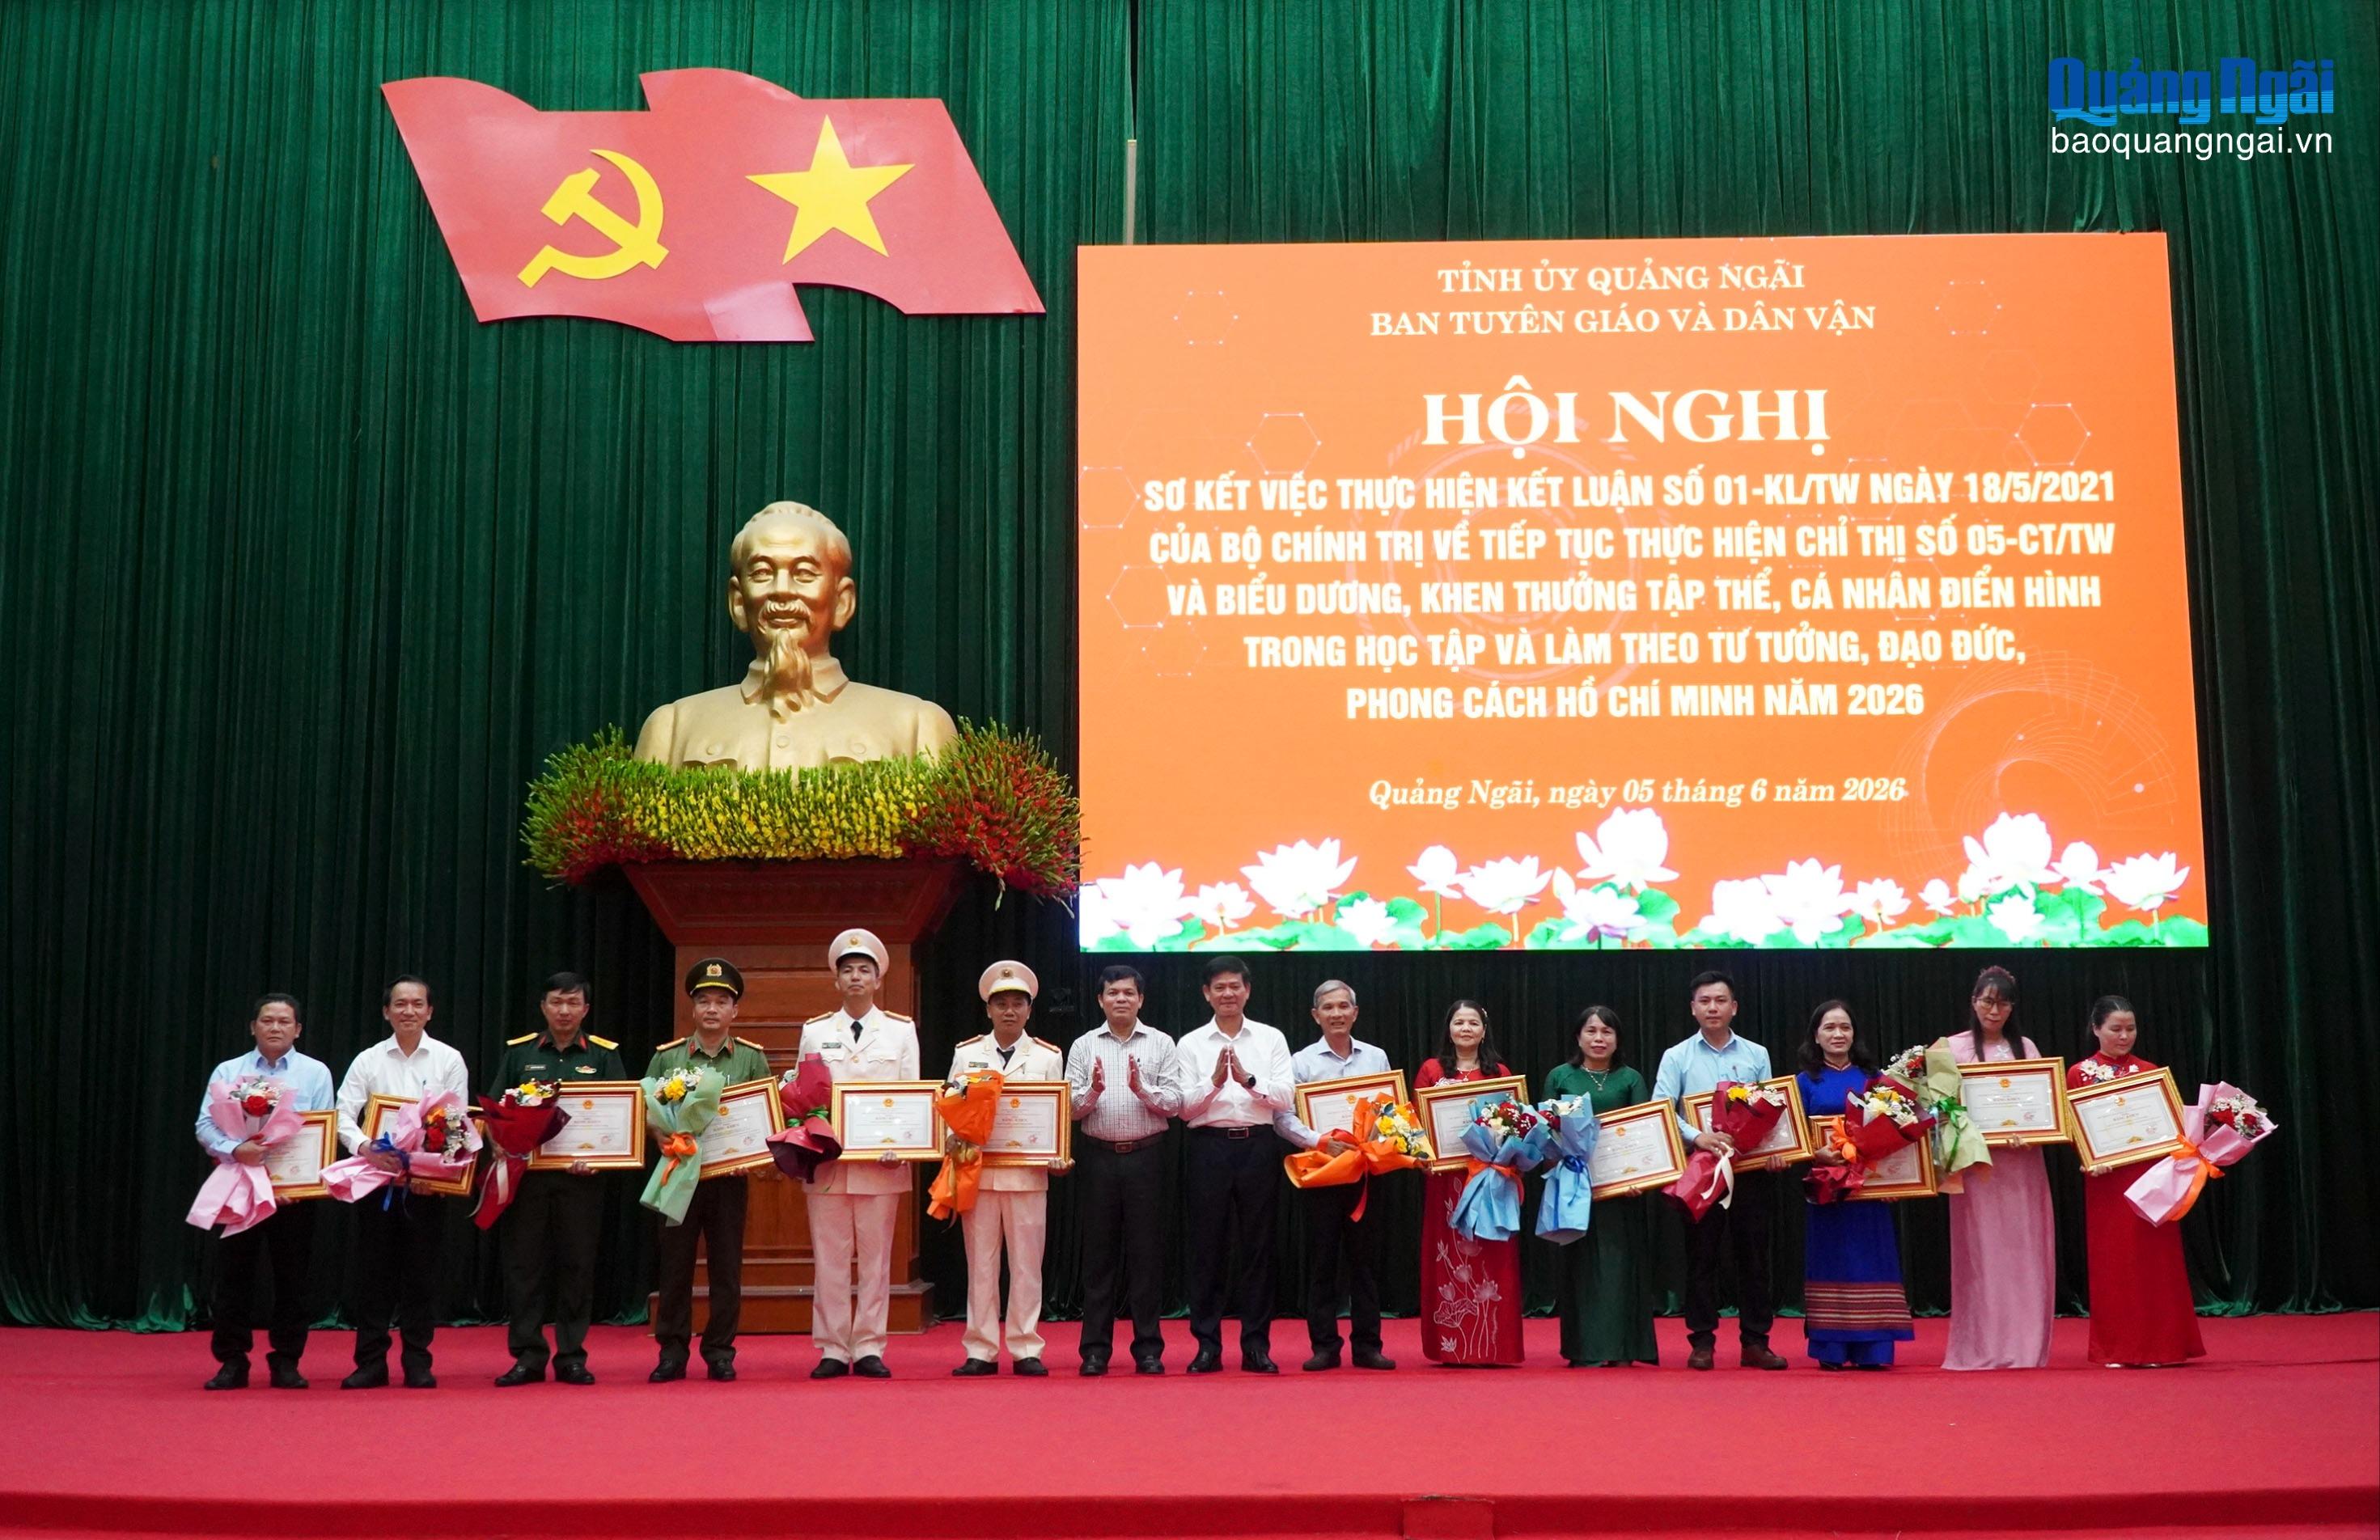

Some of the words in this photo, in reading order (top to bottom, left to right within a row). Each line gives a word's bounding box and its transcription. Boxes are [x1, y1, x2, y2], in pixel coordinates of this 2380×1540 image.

[1438, 260, 1522, 293] TỈNH
[1531, 258, 1579, 292] ỦY
[1587, 257, 1709, 294] QUẢNG
[1718, 258, 1805, 291] NGÃI
[1370, 311, 1441, 336] BAN
[1449, 303, 1565, 335] TUYÊN
[1573, 302, 1661, 333] GIÁO
[1667, 301, 1716, 332] VÀ
[1723, 300, 1796, 332] DÂN
[1803, 298, 1876, 336] VẬN
[1421, 374, 1583, 459] HỘI
[1607, 389, 1831, 456] NGHỊ
[1144, 477, 1187, 512] SƠ
[1194, 470, 1251, 510] KẾT
[1259, 470, 1328, 516] VIỆC
[1336, 476, 1417, 515] THỰC
[1424, 472, 1498, 515] HIỆN
[1506, 467, 1564, 508] KẾT
[1573, 468, 1654, 513] LUẬN
[1662, 463, 1705, 506] SỐ
[1713, 472, 1861, 506] 01-KL/TW
[1870, 465, 1954, 503] NGÀY
[1963, 470, 2115, 503] 18/5/2021
[1150, 522, 1212, 564] CỦA
[1220, 524, 1263, 569] BỘ
[1271, 525, 1367, 563] CHÍNH
[1376, 531, 1424, 567] TRỊ
[1480, 520, 1547, 560] TIẾP
[1558, 528, 1616, 565] TỤC
[1624, 524, 1704, 565] THỰC
[1713, 520, 1786, 564] HIỆN
[1796, 516, 1848, 557] CHỈ
[1857, 525, 1906, 563] THỊ
[1915, 514, 1959, 556] SỐ
[1967, 522, 2115, 556] 05-CT/TW
[1167, 578, 1208, 616] VÀ
[1215, 571, 1286, 616] BIỂU
[1295, 578, 1412, 618] DƯƠNG,
[1421, 582, 1504, 613] KHEN
[1513, 572, 1637, 612] THƯỞNG
[1645, 571, 1705, 617] TẬP
[1713, 566, 1781, 614] THỂ,
[1791, 572, 1833, 610] CÁ
[1841, 570, 1931, 609] NHÂN
[1939, 565, 2015, 608] ĐIỂN
[2024, 569, 2102, 608] HÌNH
[1243, 636, 1346, 668] TRONG
[1356, 635, 1418, 672] HỌC
[1426, 628, 1486, 672] TẬP
[1495, 627, 1536, 665] VÀ
[1544, 627, 1611, 665] LÀM
[1620, 632, 1700, 664] THEO
[1708, 627, 1751, 663] TƯ
[1755, 622, 1870, 666] TƯỞNG,
[1878, 630, 1942, 668] ĐẠO
[1950, 624, 2026, 665] ĐỨC,
[1346, 688, 1455, 720] PHONG
[1462, 679, 1548, 719] CÁCH
[1556, 676, 1599, 718] HỒ
[1607, 679, 1661, 717] CHÍ
[1671, 685, 1755, 717] MINH
[1764, 678, 1839, 717] NĂM
[1848, 683, 1925, 716] 2026
[1369, 777, 1463, 810] Quảng
[1467, 779, 1541, 810] Ngãi,
[1548, 778, 1617, 809] ngày
[1623, 778, 1656, 802] 05
[1662, 777, 1745, 808] tháng
[1750, 777, 1768, 802] 6
[1773, 778, 1835, 802] năm
[1841, 776, 1906, 802] 2026
